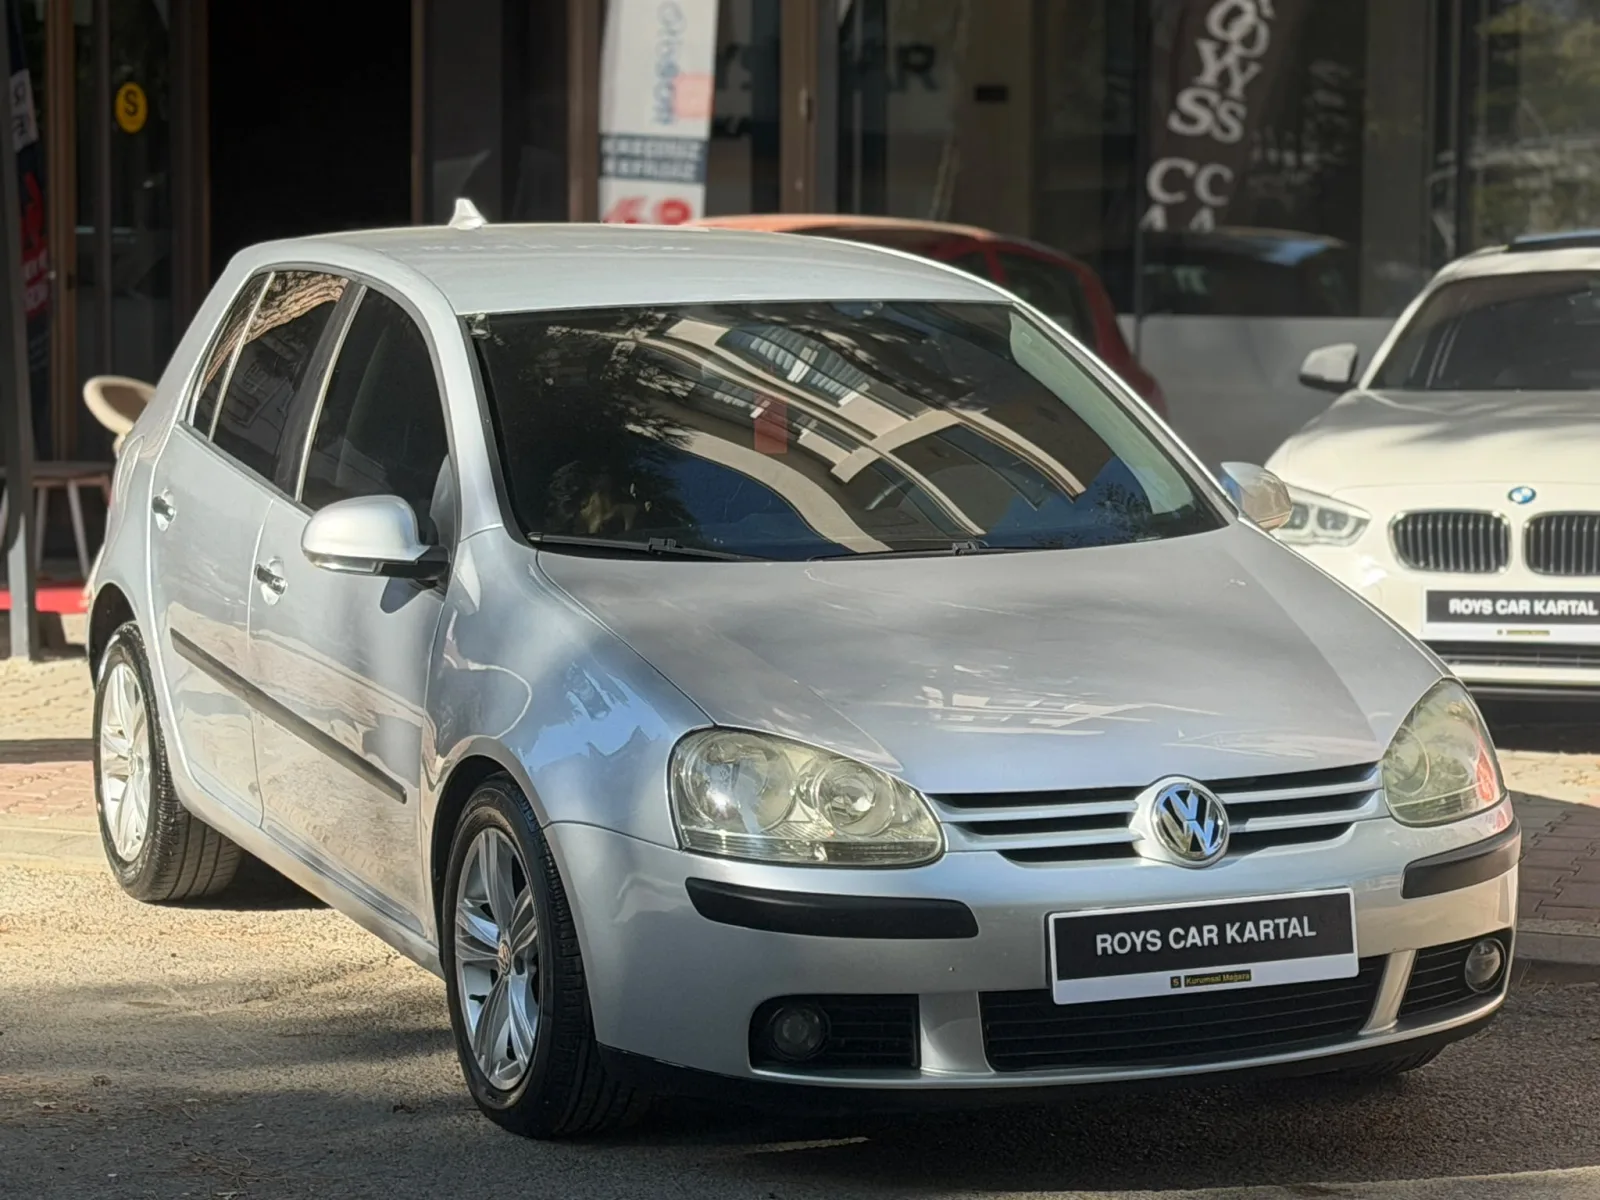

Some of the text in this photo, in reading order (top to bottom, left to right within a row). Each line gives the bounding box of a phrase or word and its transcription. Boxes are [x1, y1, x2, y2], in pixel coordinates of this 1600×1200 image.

[1448, 598, 1599, 616] ROYS CAR KARTAL
[1096, 915, 1317, 956] ROYS CAR KARTAL
[1186, 974, 1222, 986] Kurumsal
